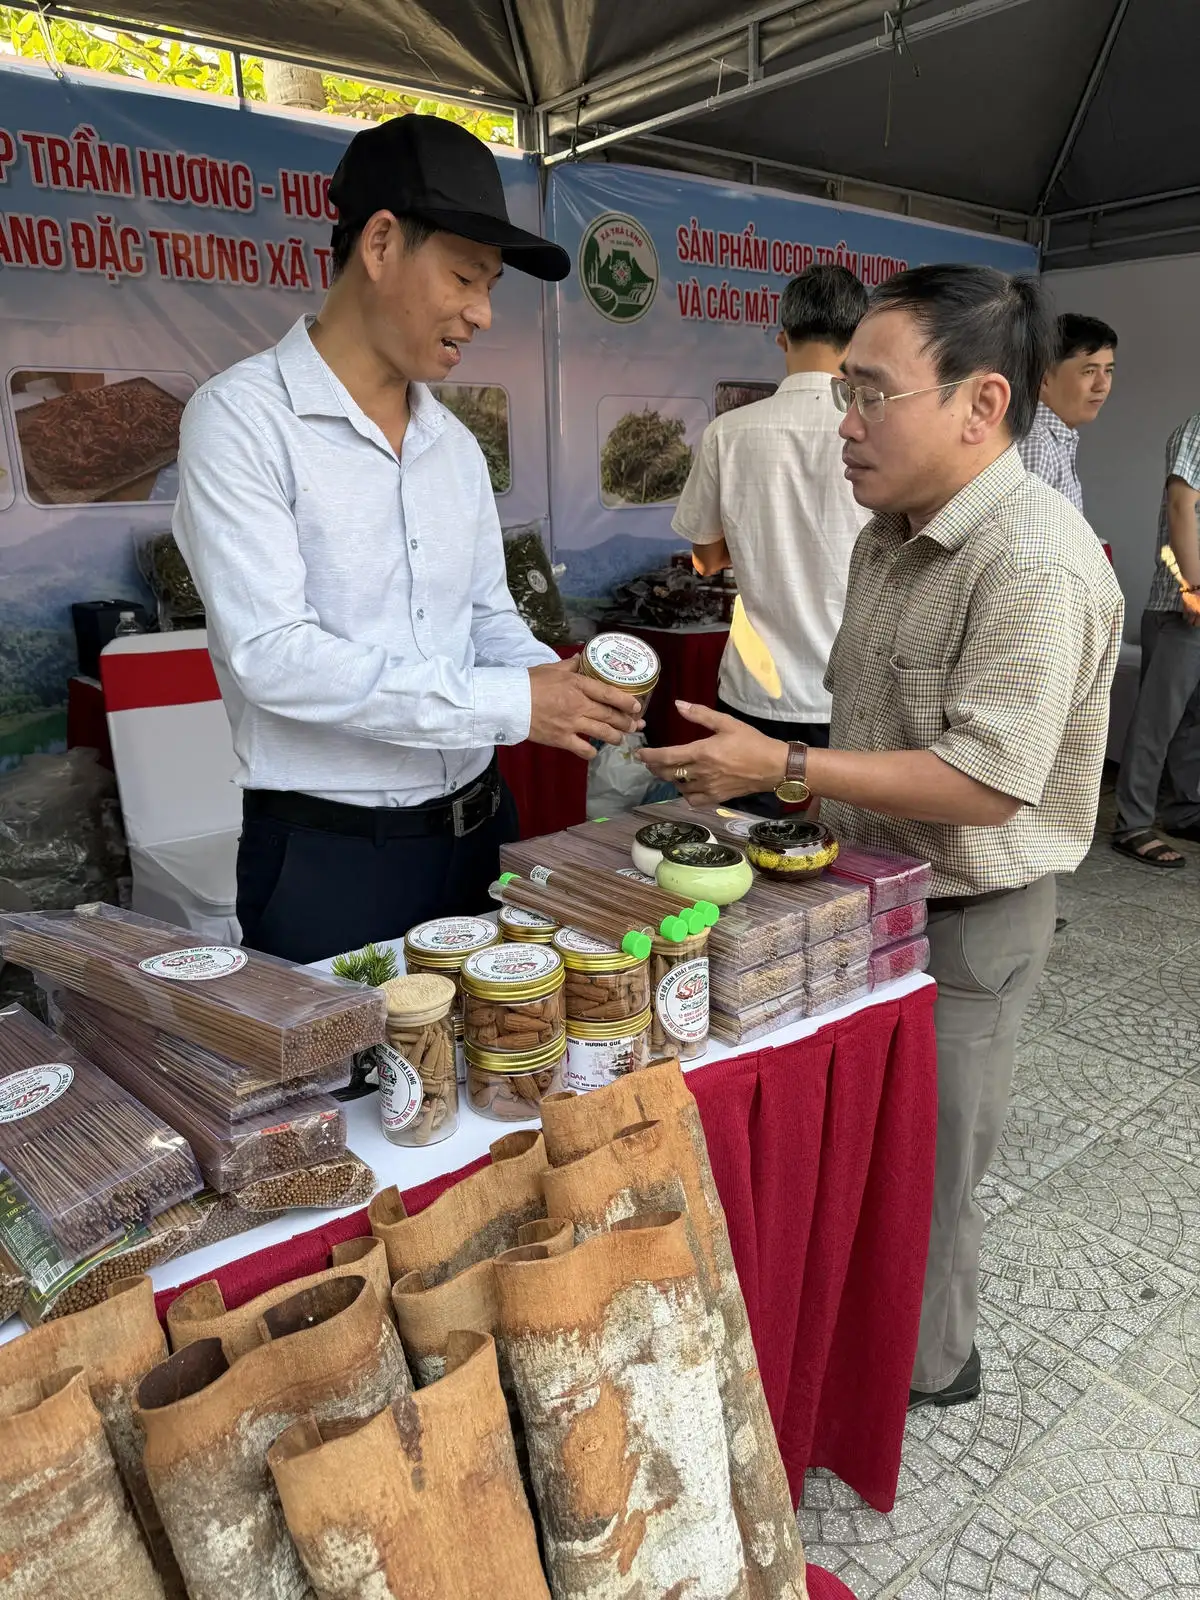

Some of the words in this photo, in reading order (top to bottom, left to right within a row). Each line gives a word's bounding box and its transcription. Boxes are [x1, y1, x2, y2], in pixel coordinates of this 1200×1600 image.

[21, 127, 133, 194] TRẦM
[139, 150, 251, 209] HƯƠNG
[71, 215, 143, 280] ĐẶC
[149, 230, 259, 283] TRƯNG
[265, 237, 310, 288] XÃ
[677, 218, 714, 264] SẢN
[718, 223, 768, 271] PHẨM
[772, 240, 813, 275] OCOP
[677, 278, 702, 318] VÀ
[706, 281, 740, 321] CÁC
[744, 286, 780, 330] MẶT
[674, 967, 687, 979] XUẤT
[398, 1060, 408, 1072] TRÀ
[406, 1070, 417, 1086] LENG
